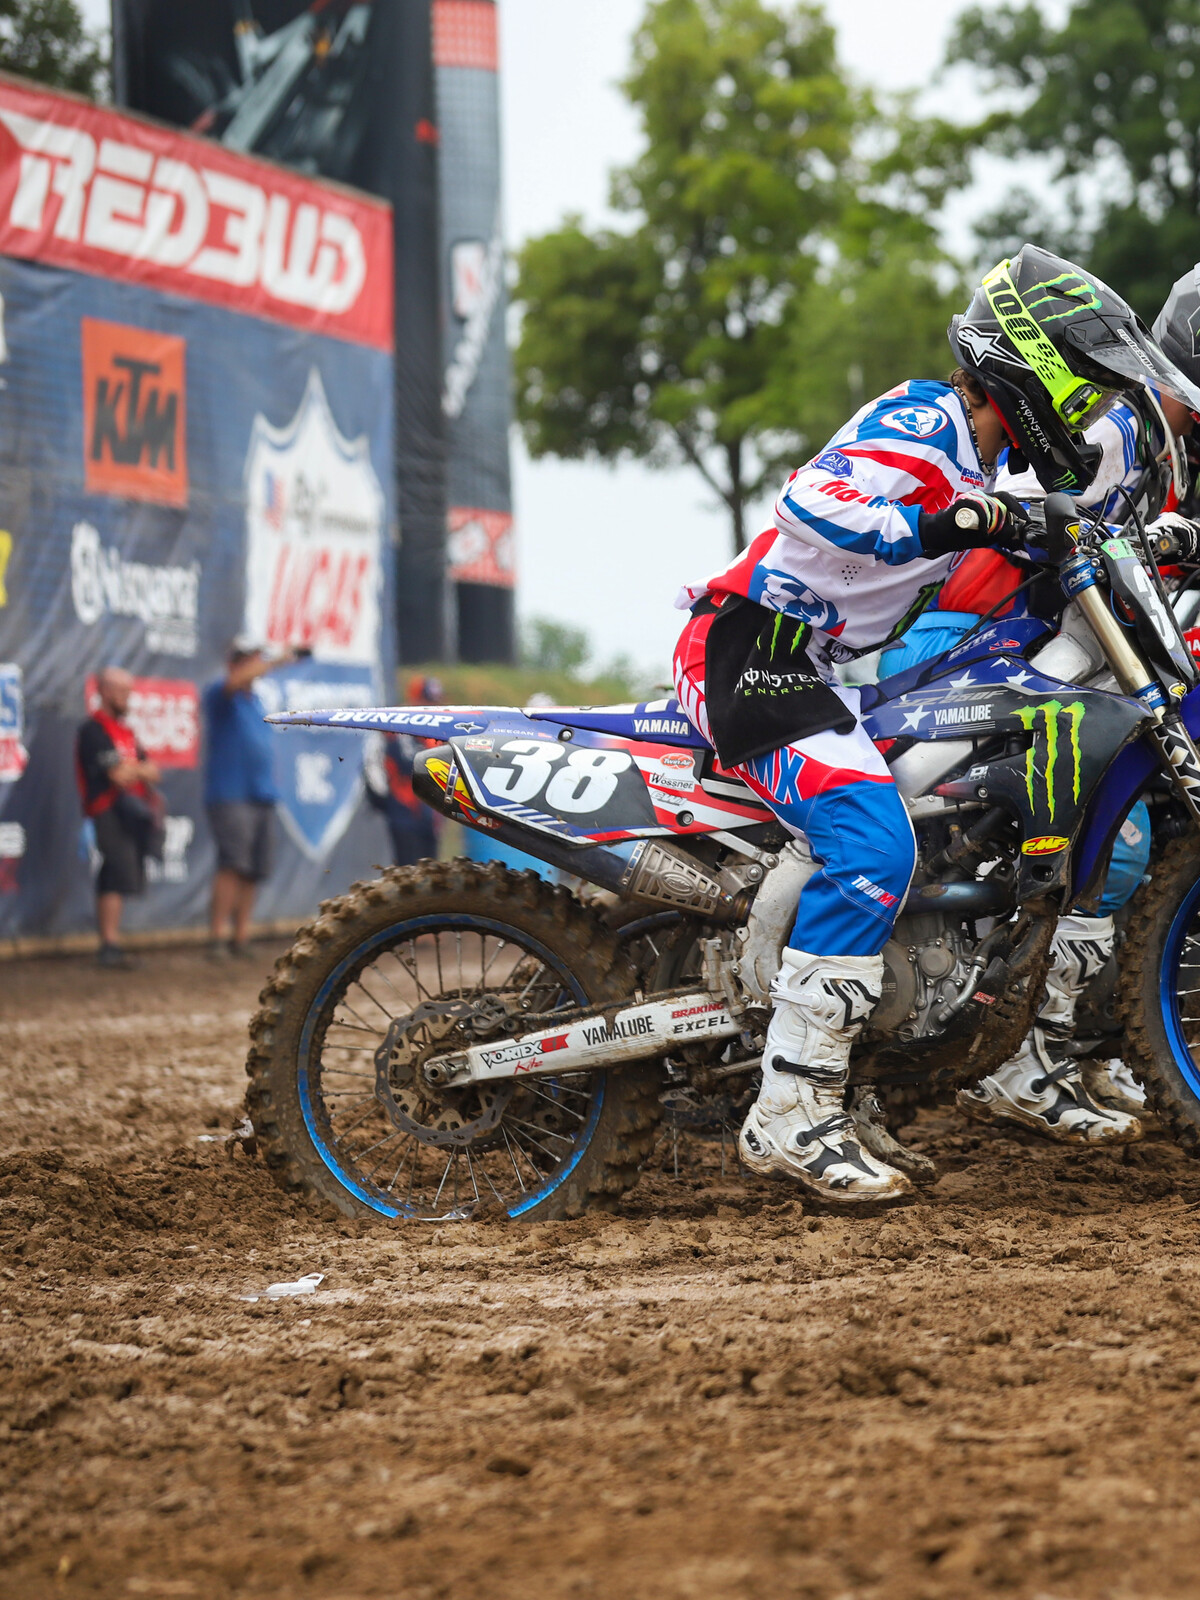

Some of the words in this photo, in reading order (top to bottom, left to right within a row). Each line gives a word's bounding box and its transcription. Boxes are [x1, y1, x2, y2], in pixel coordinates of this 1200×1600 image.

[988, 278, 1068, 380] 100%
[91, 357, 178, 472] KTM
[1016, 410, 1038, 448] ENERGY
[1019, 399, 1051, 453] MONSTER
[744, 684, 815, 697] ENERGY
[328, 711, 455, 728] DUNLOP
[934, 704, 992, 726] YAMALUBE
[493, 727, 535, 737] DEEGAN
[633, 719, 690, 735] YAMAHA
[481, 738, 632, 814] 38
[1021, 837, 1070, 853] FMF
[671, 1001, 727, 1020] BRAKING
[673, 1015, 730, 1035] EXCEL
[480, 1039, 544, 1069] VORTEX
